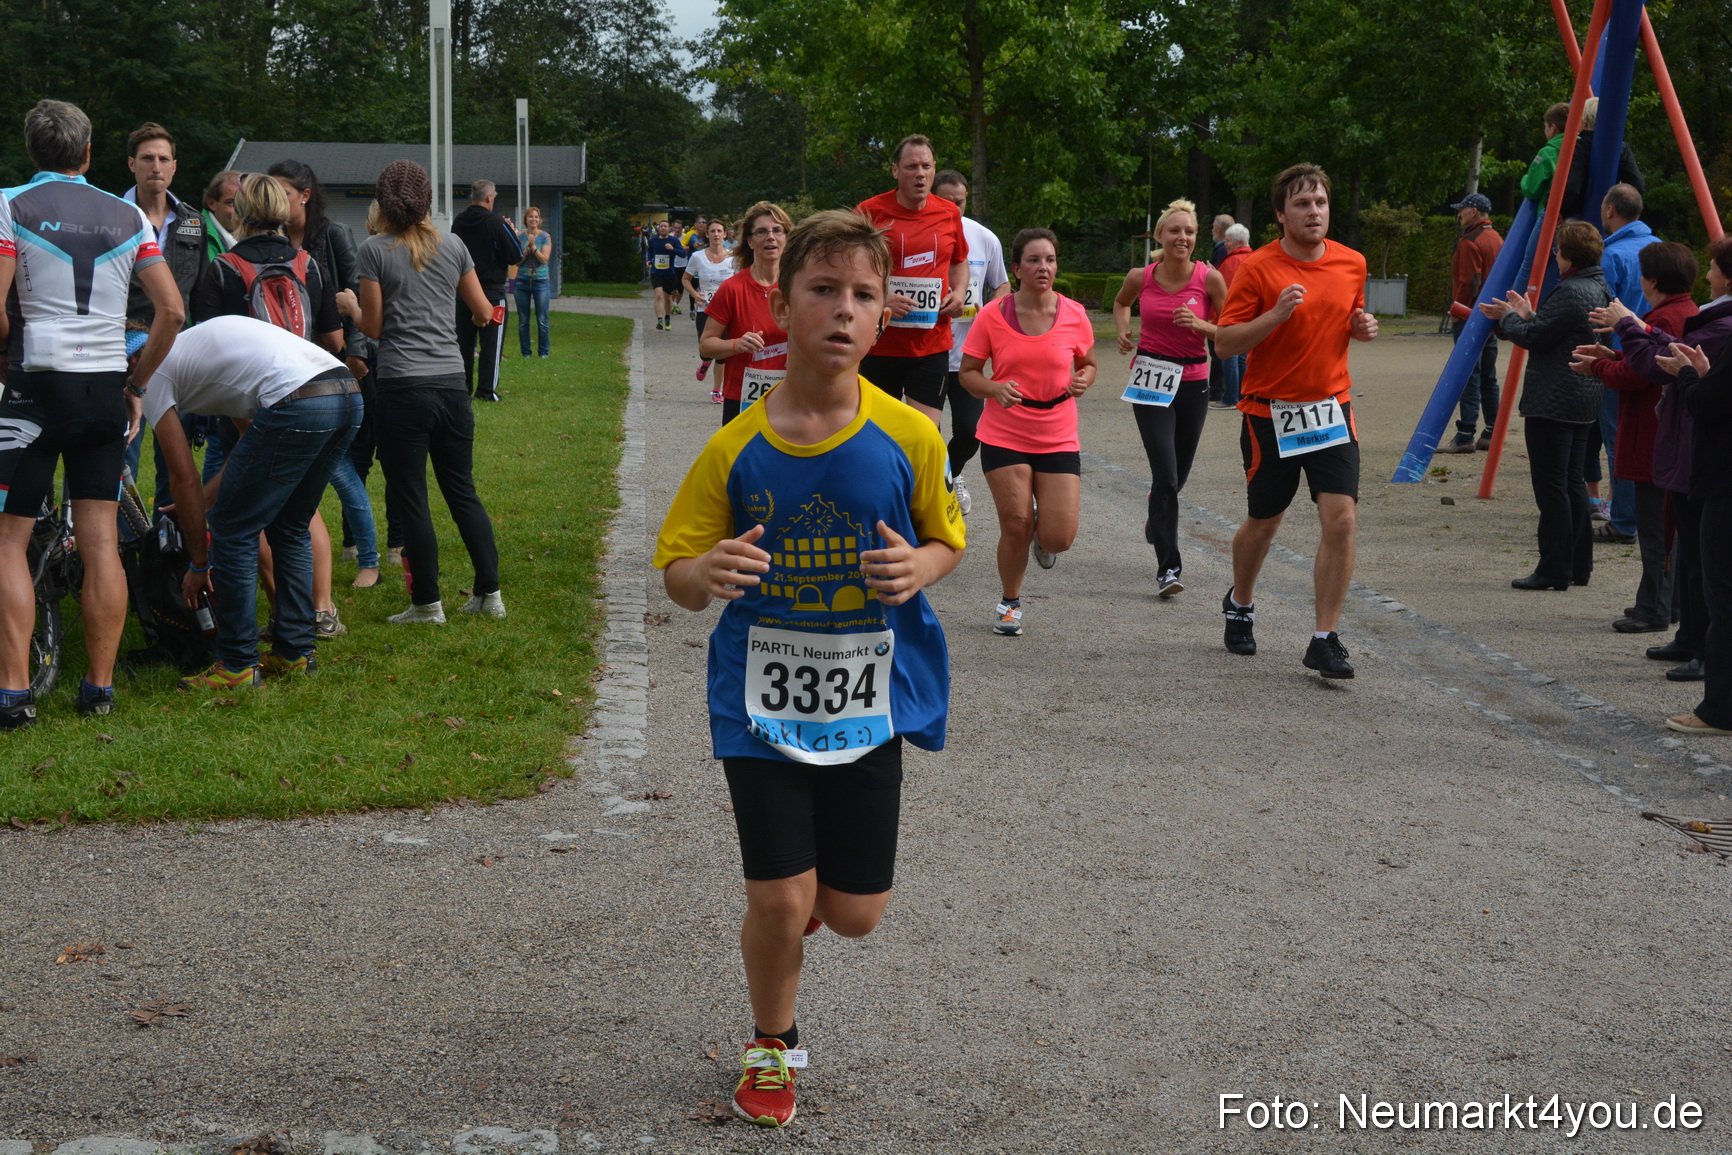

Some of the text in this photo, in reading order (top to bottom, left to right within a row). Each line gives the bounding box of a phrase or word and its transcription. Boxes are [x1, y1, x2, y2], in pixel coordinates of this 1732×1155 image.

[1148, 362, 1173, 371] Neumarkt
[745, 372, 763, 380] PARTL
[1133, 367, 1175, 392] 2114
[1136, 391, 1159, 402] Andrea
[1280, 403, 1334, 433] 2117
[1296, 433, 1330, 446] Markus
[751, 640, 869, 660] PARTL Neumarkt
[761, 662, 876, 715] 3334
